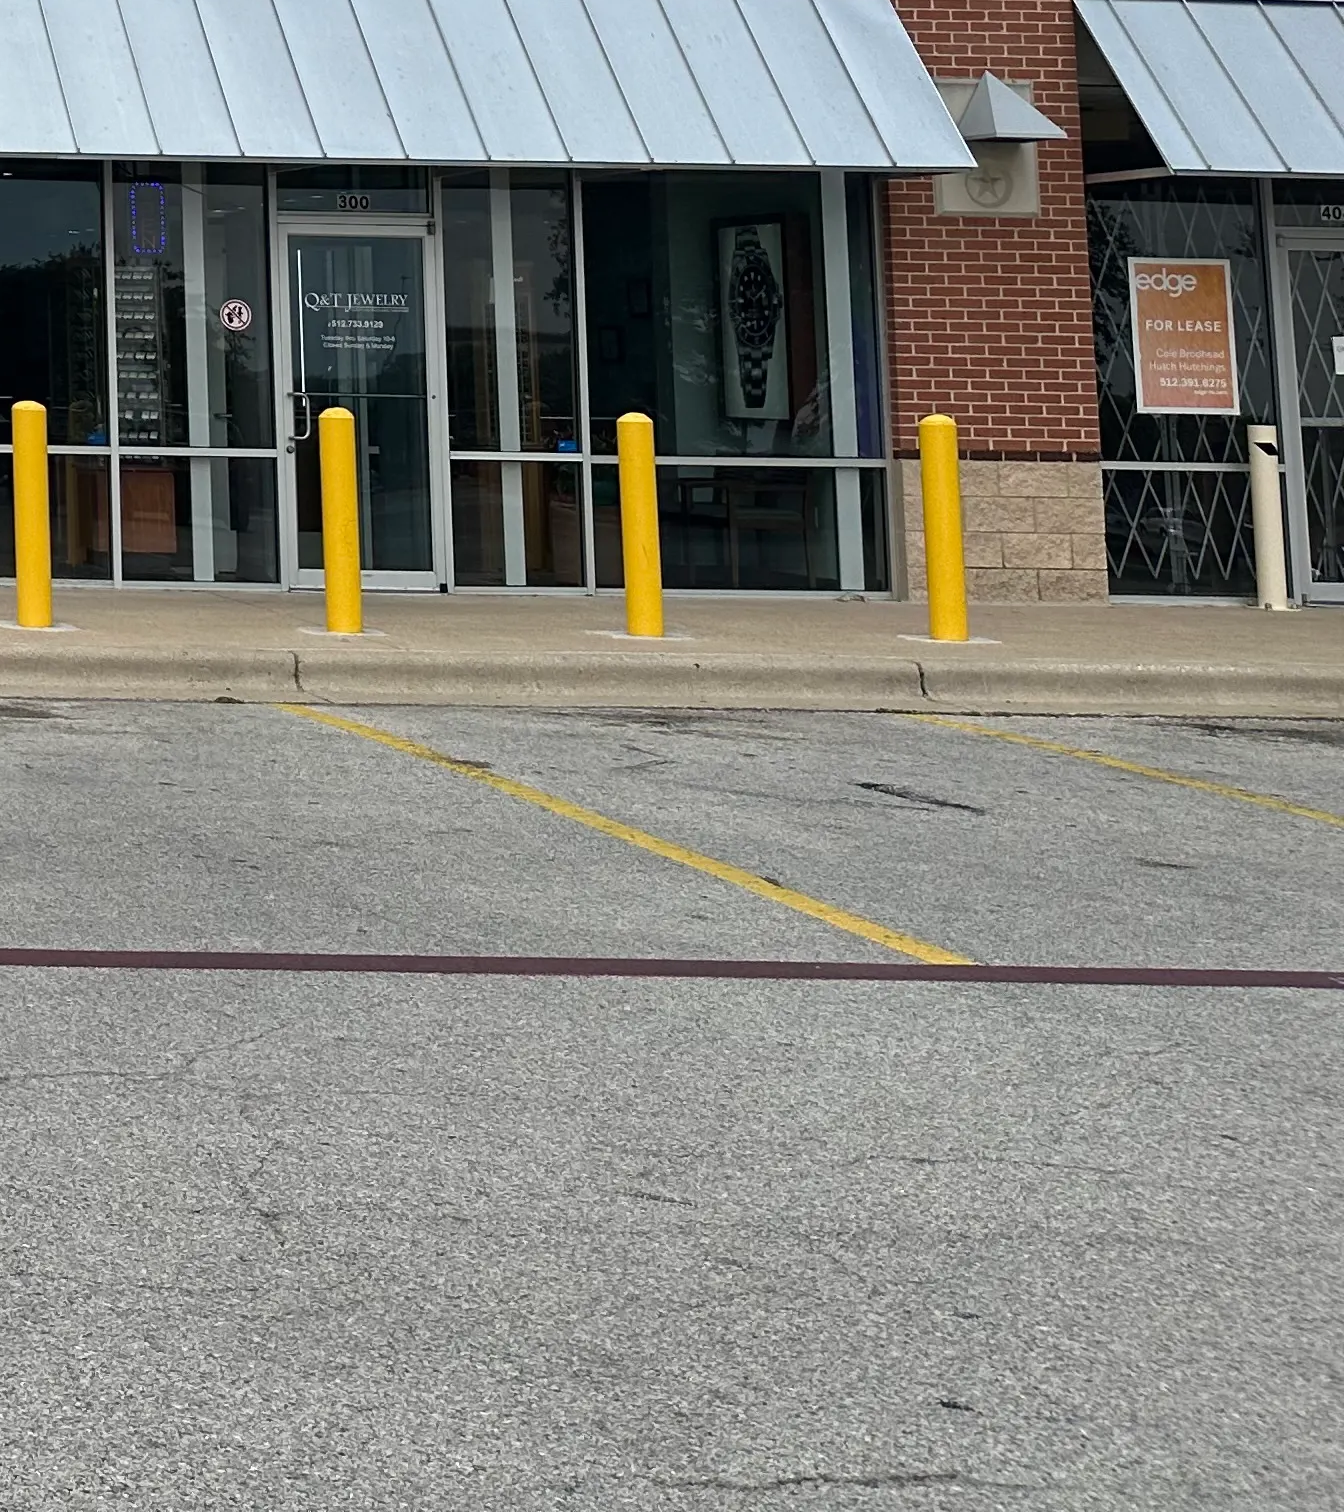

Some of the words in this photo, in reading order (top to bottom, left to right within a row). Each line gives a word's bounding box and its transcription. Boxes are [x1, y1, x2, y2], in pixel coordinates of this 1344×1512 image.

[338, 194, 370, 210] 300
[1321, 206, 1344, 220] 40
[1135, 268, 1197, 298] edge
[304, 292, 342, 312] Q&T
[344, 293, 409, 313] JEWELRY
[1145, 320, 1173, 331] FOR
[1177, 320, 1222, 332] LEASE
